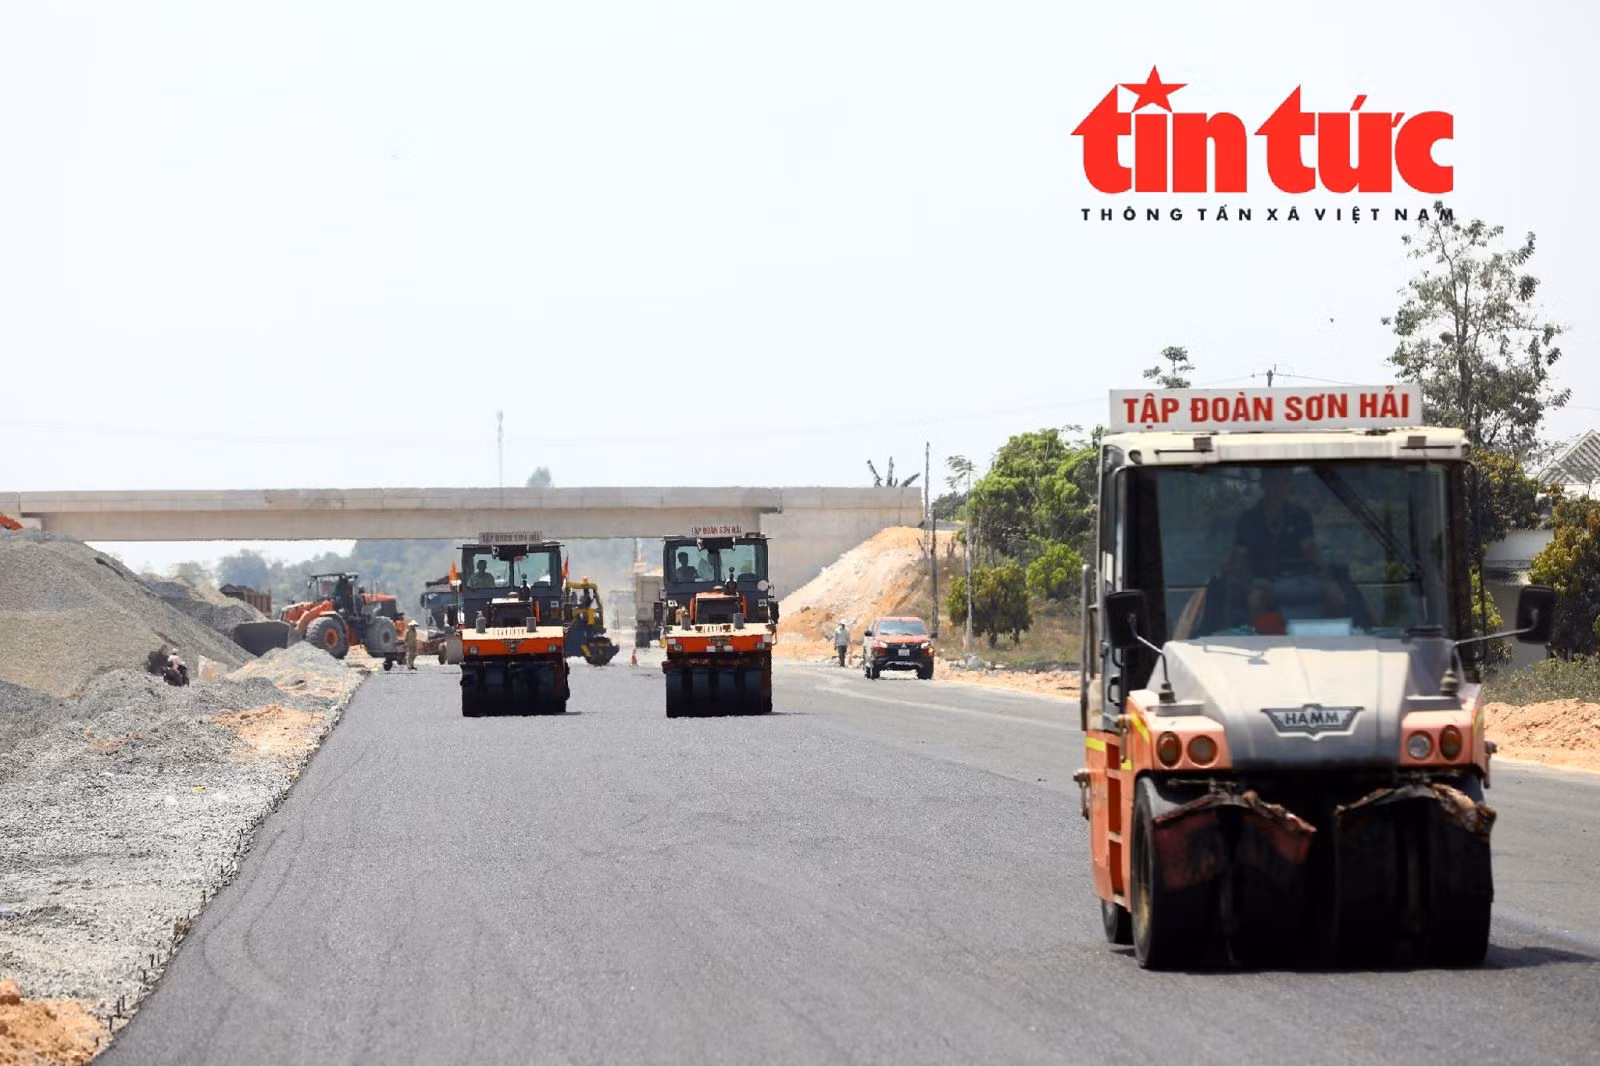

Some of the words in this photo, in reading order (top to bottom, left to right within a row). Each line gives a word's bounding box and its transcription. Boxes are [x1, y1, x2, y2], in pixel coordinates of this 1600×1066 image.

[1123, 393, 1180, 429] TẬP
[1190, 392, 1273, 422] ĐOÀN
[1284, 393, 1348, 422] SƠN
[1359, 386, 1409, 418] HẢI
[1284, 711, 1340, 725] HAMM
